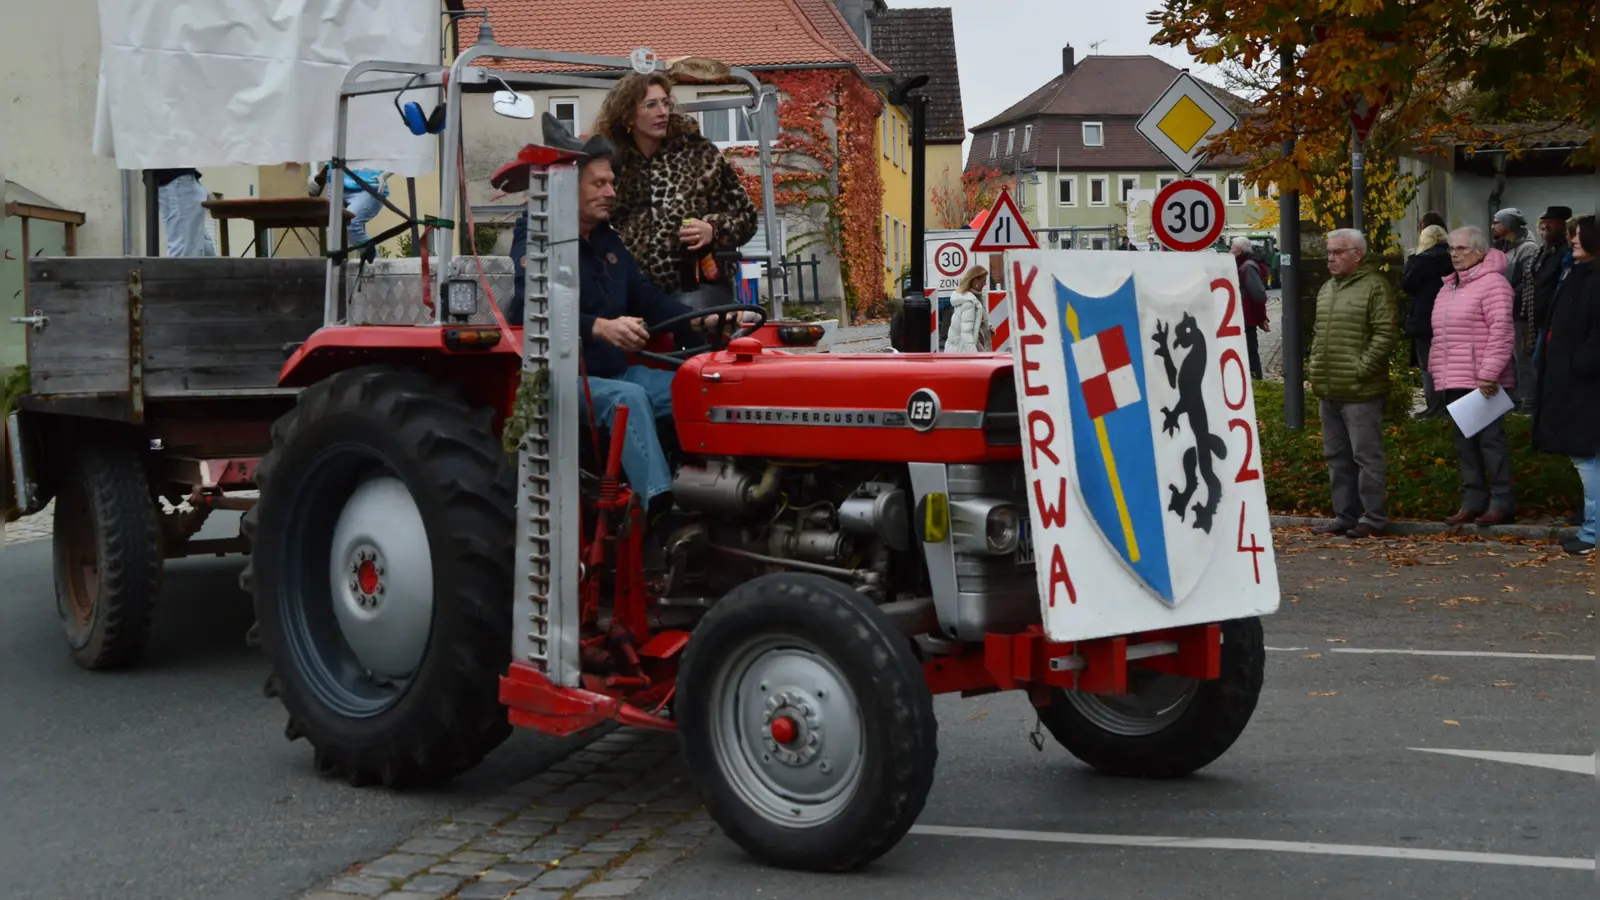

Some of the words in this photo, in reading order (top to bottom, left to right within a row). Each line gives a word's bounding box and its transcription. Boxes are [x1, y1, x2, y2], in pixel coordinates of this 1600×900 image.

[1168, 200, 1209, 233] 30
[941, 252, 960, 267] 30
[939, 279, 960, 288] ZON
[910, 401, 933, 419] 133
[1013, 261, 1077, 607] KERWA
[1210, 278, 1265, 584] 2024
